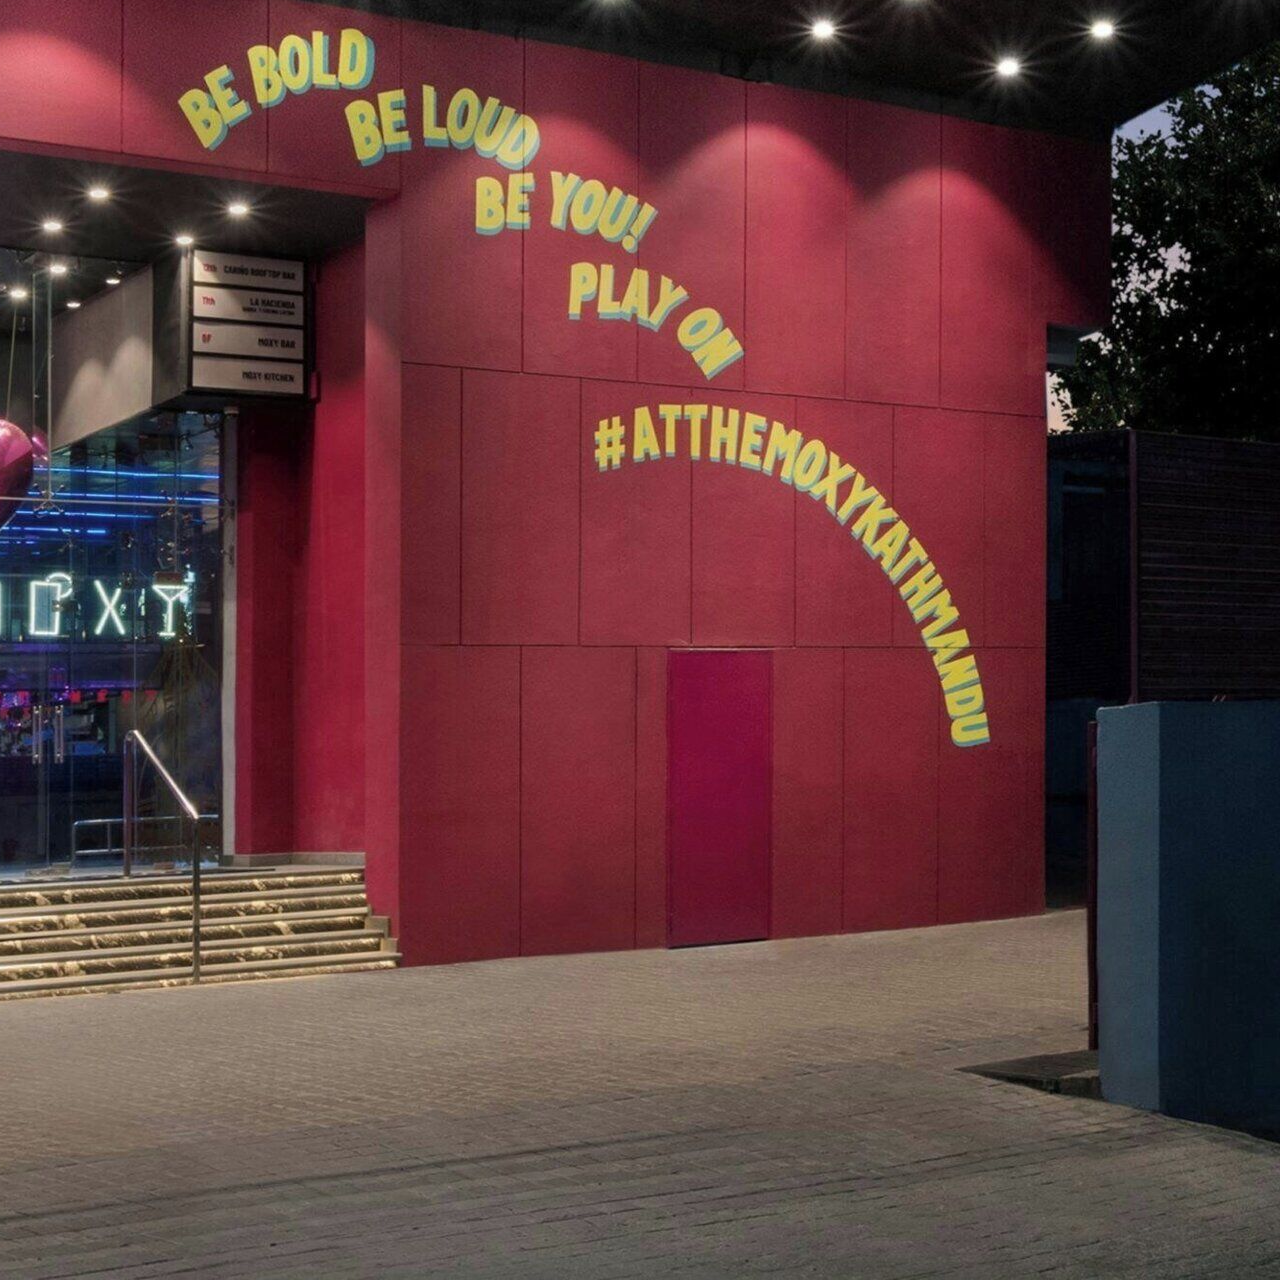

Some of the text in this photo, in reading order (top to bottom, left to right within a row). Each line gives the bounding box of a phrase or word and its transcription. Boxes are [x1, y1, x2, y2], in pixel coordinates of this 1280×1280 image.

[178, 28, 376, 150] BE BOLD
[345, 85, 541, 170] BE LOUD
[476, 171, 658, 253] BE YOU!
[258, 338, 279, 348] MOXY
[281, 339, 296, 349] BAR
[568, 262, 745, 381] PLAY ON
[242, 371, 295, 383] MOXY KITCHEN
[594, 404, 990, 747] #ATTHEMOXYKATHMANDU
